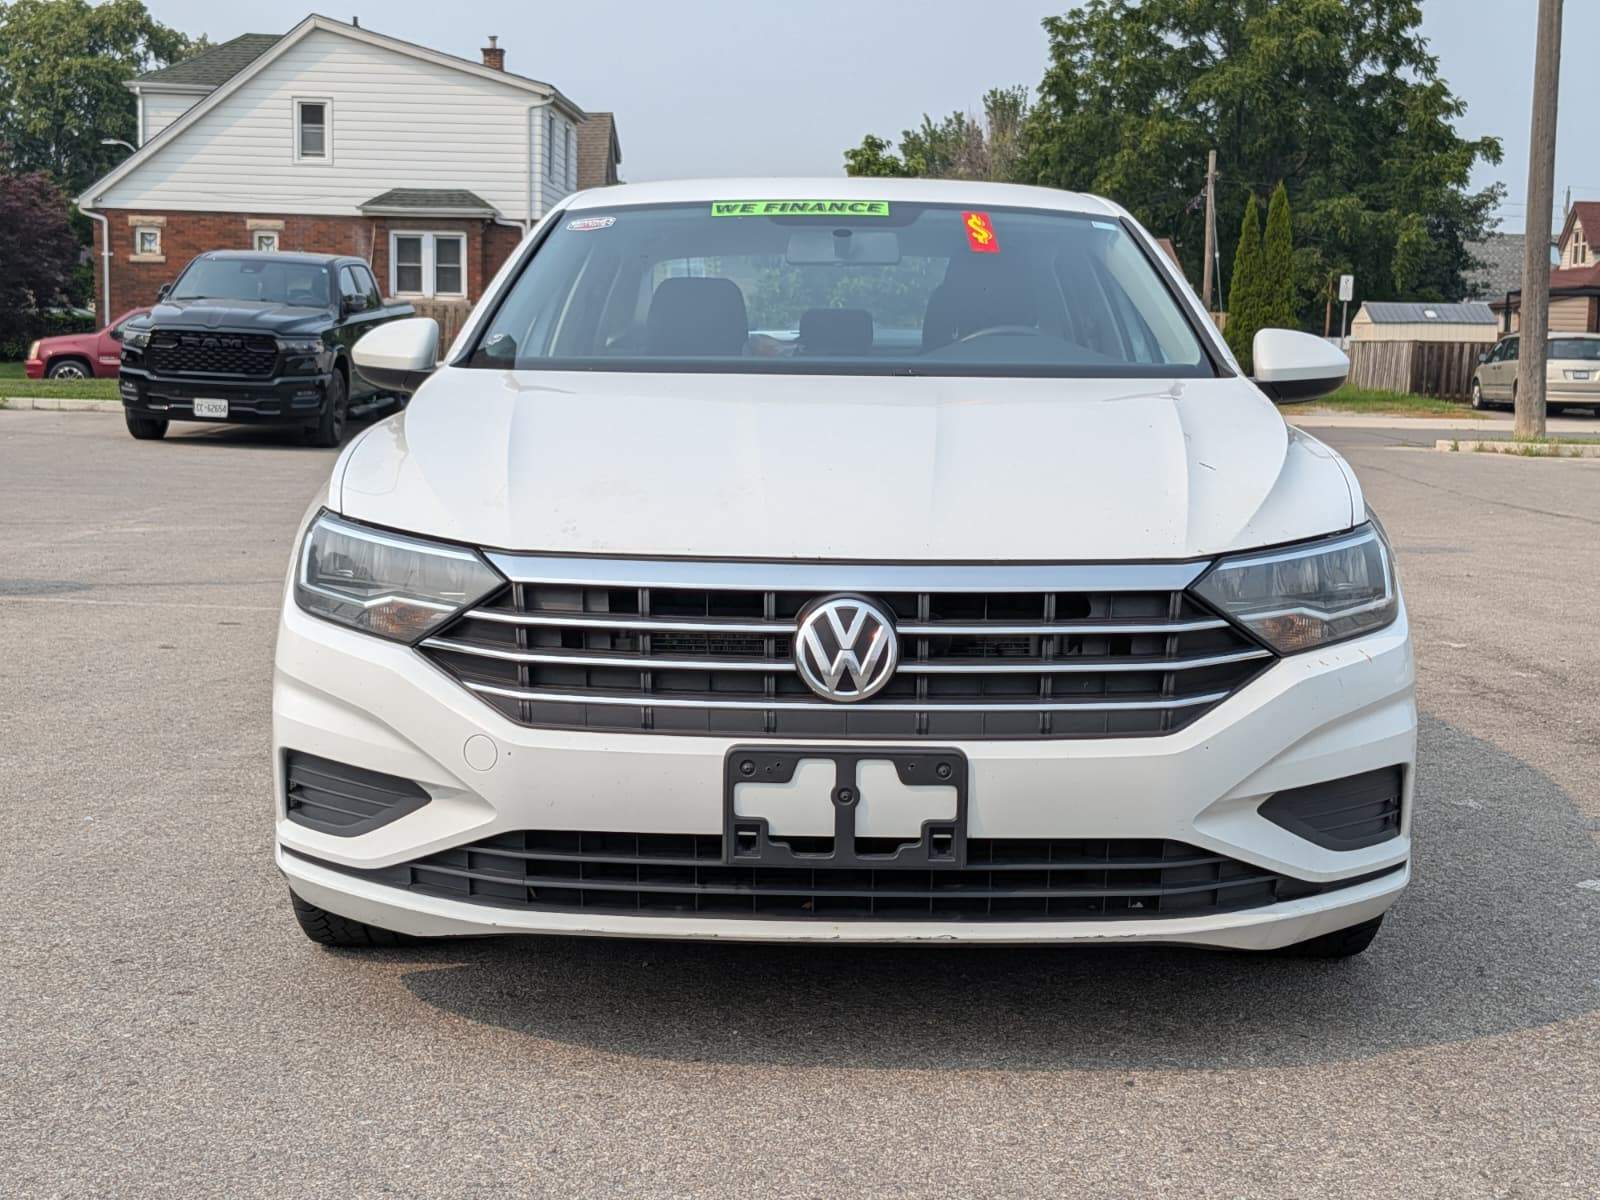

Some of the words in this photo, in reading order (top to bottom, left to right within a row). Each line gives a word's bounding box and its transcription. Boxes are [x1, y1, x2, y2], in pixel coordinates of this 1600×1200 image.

[715, 202, 758, 214] WE
[763, 201, 887, 213] FINANCE
[180, 335, 243, 349] RAM
